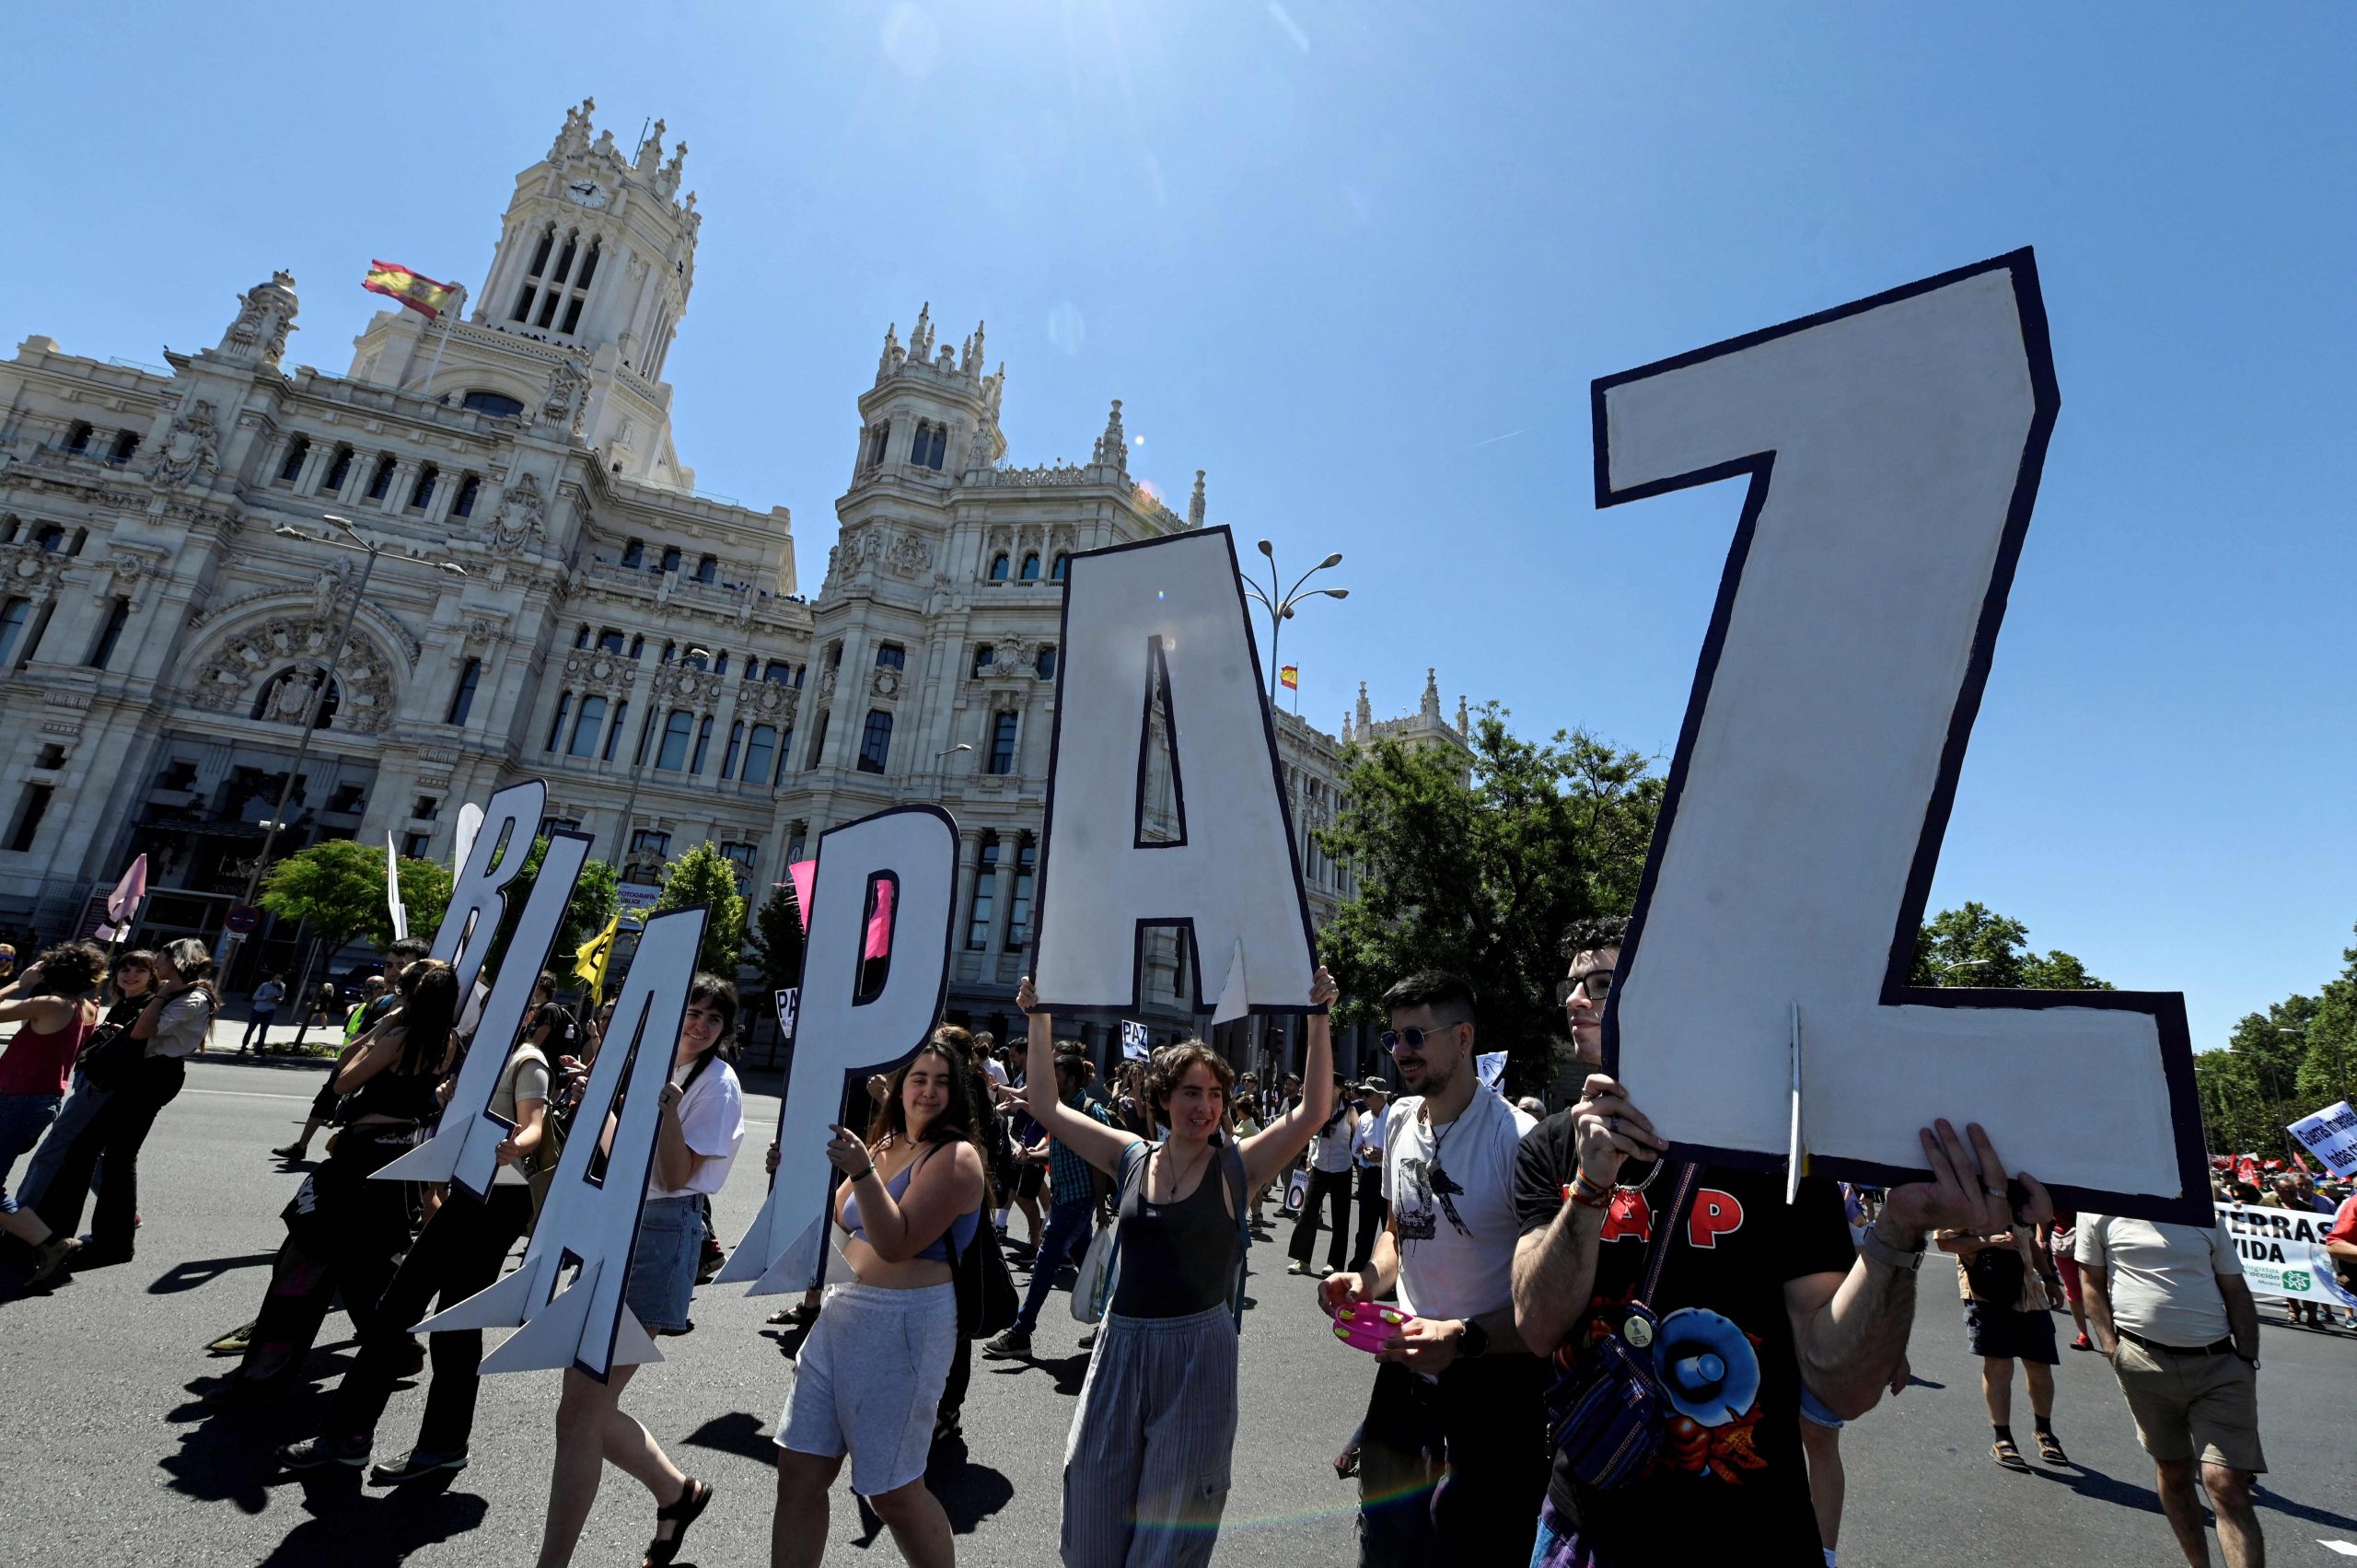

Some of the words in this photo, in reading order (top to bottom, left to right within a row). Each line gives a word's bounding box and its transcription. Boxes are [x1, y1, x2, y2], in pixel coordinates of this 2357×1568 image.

[776, 989, 798, 1019] PA
[1122, 1021, 1147, 1048] PAZ
[2296, 1122, 2333, 1147] Guerras
[2324, 1148, 2357, 1169] todas
[2219, 1210, 2332, 1245] ERRAS
[2249, 1272, 2280, 1281] acción
